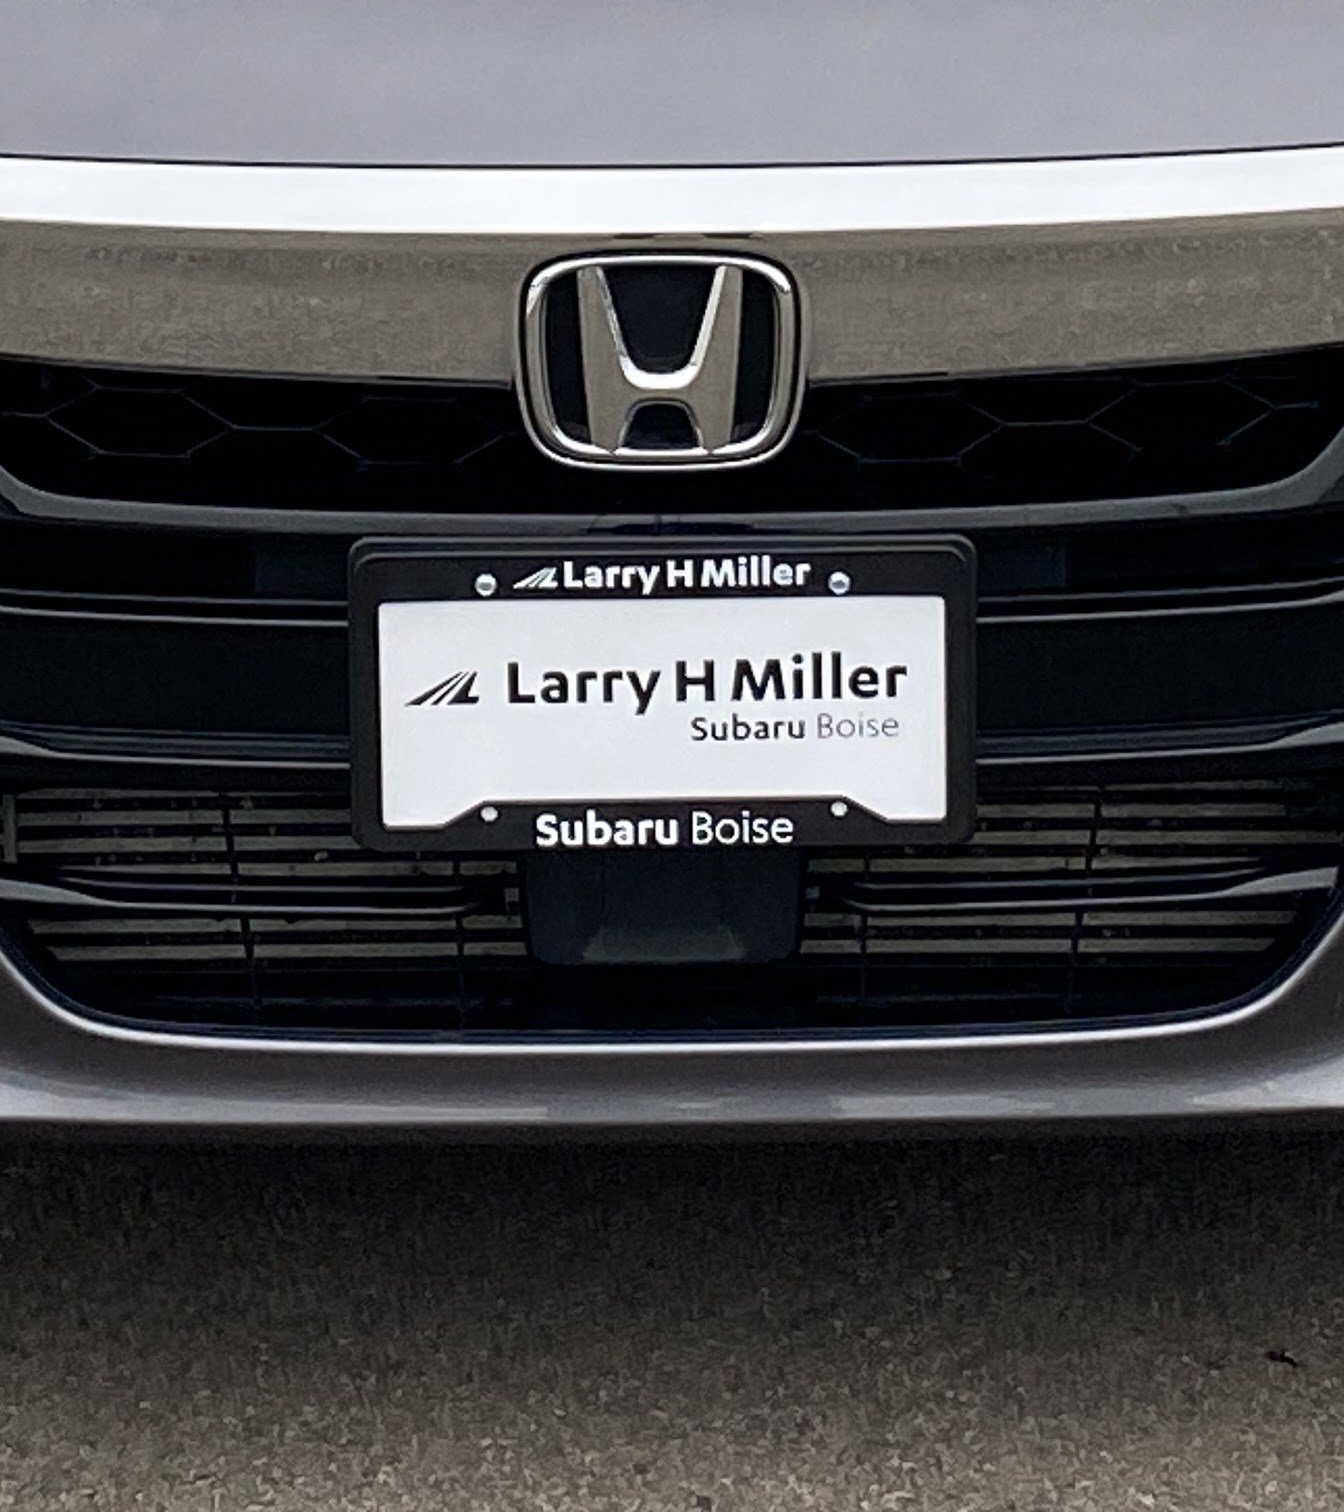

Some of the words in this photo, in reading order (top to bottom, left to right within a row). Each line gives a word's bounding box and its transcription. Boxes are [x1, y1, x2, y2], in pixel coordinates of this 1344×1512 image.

[563, 561, 660, 595] Larry
[666, 559, 694, 588] H
[701, 555, 811, 588] Miller
[507, 661, 661, 715] Larry
[675, 659, 716, 703] H
[730, 651, 908, 701] Miller
[690, 714, 806, 741] Subaru
[816, 712, 900, 739] Boise
[535, 809, 679, 847] Subaru
[692, 810, 794, 844] Boise
